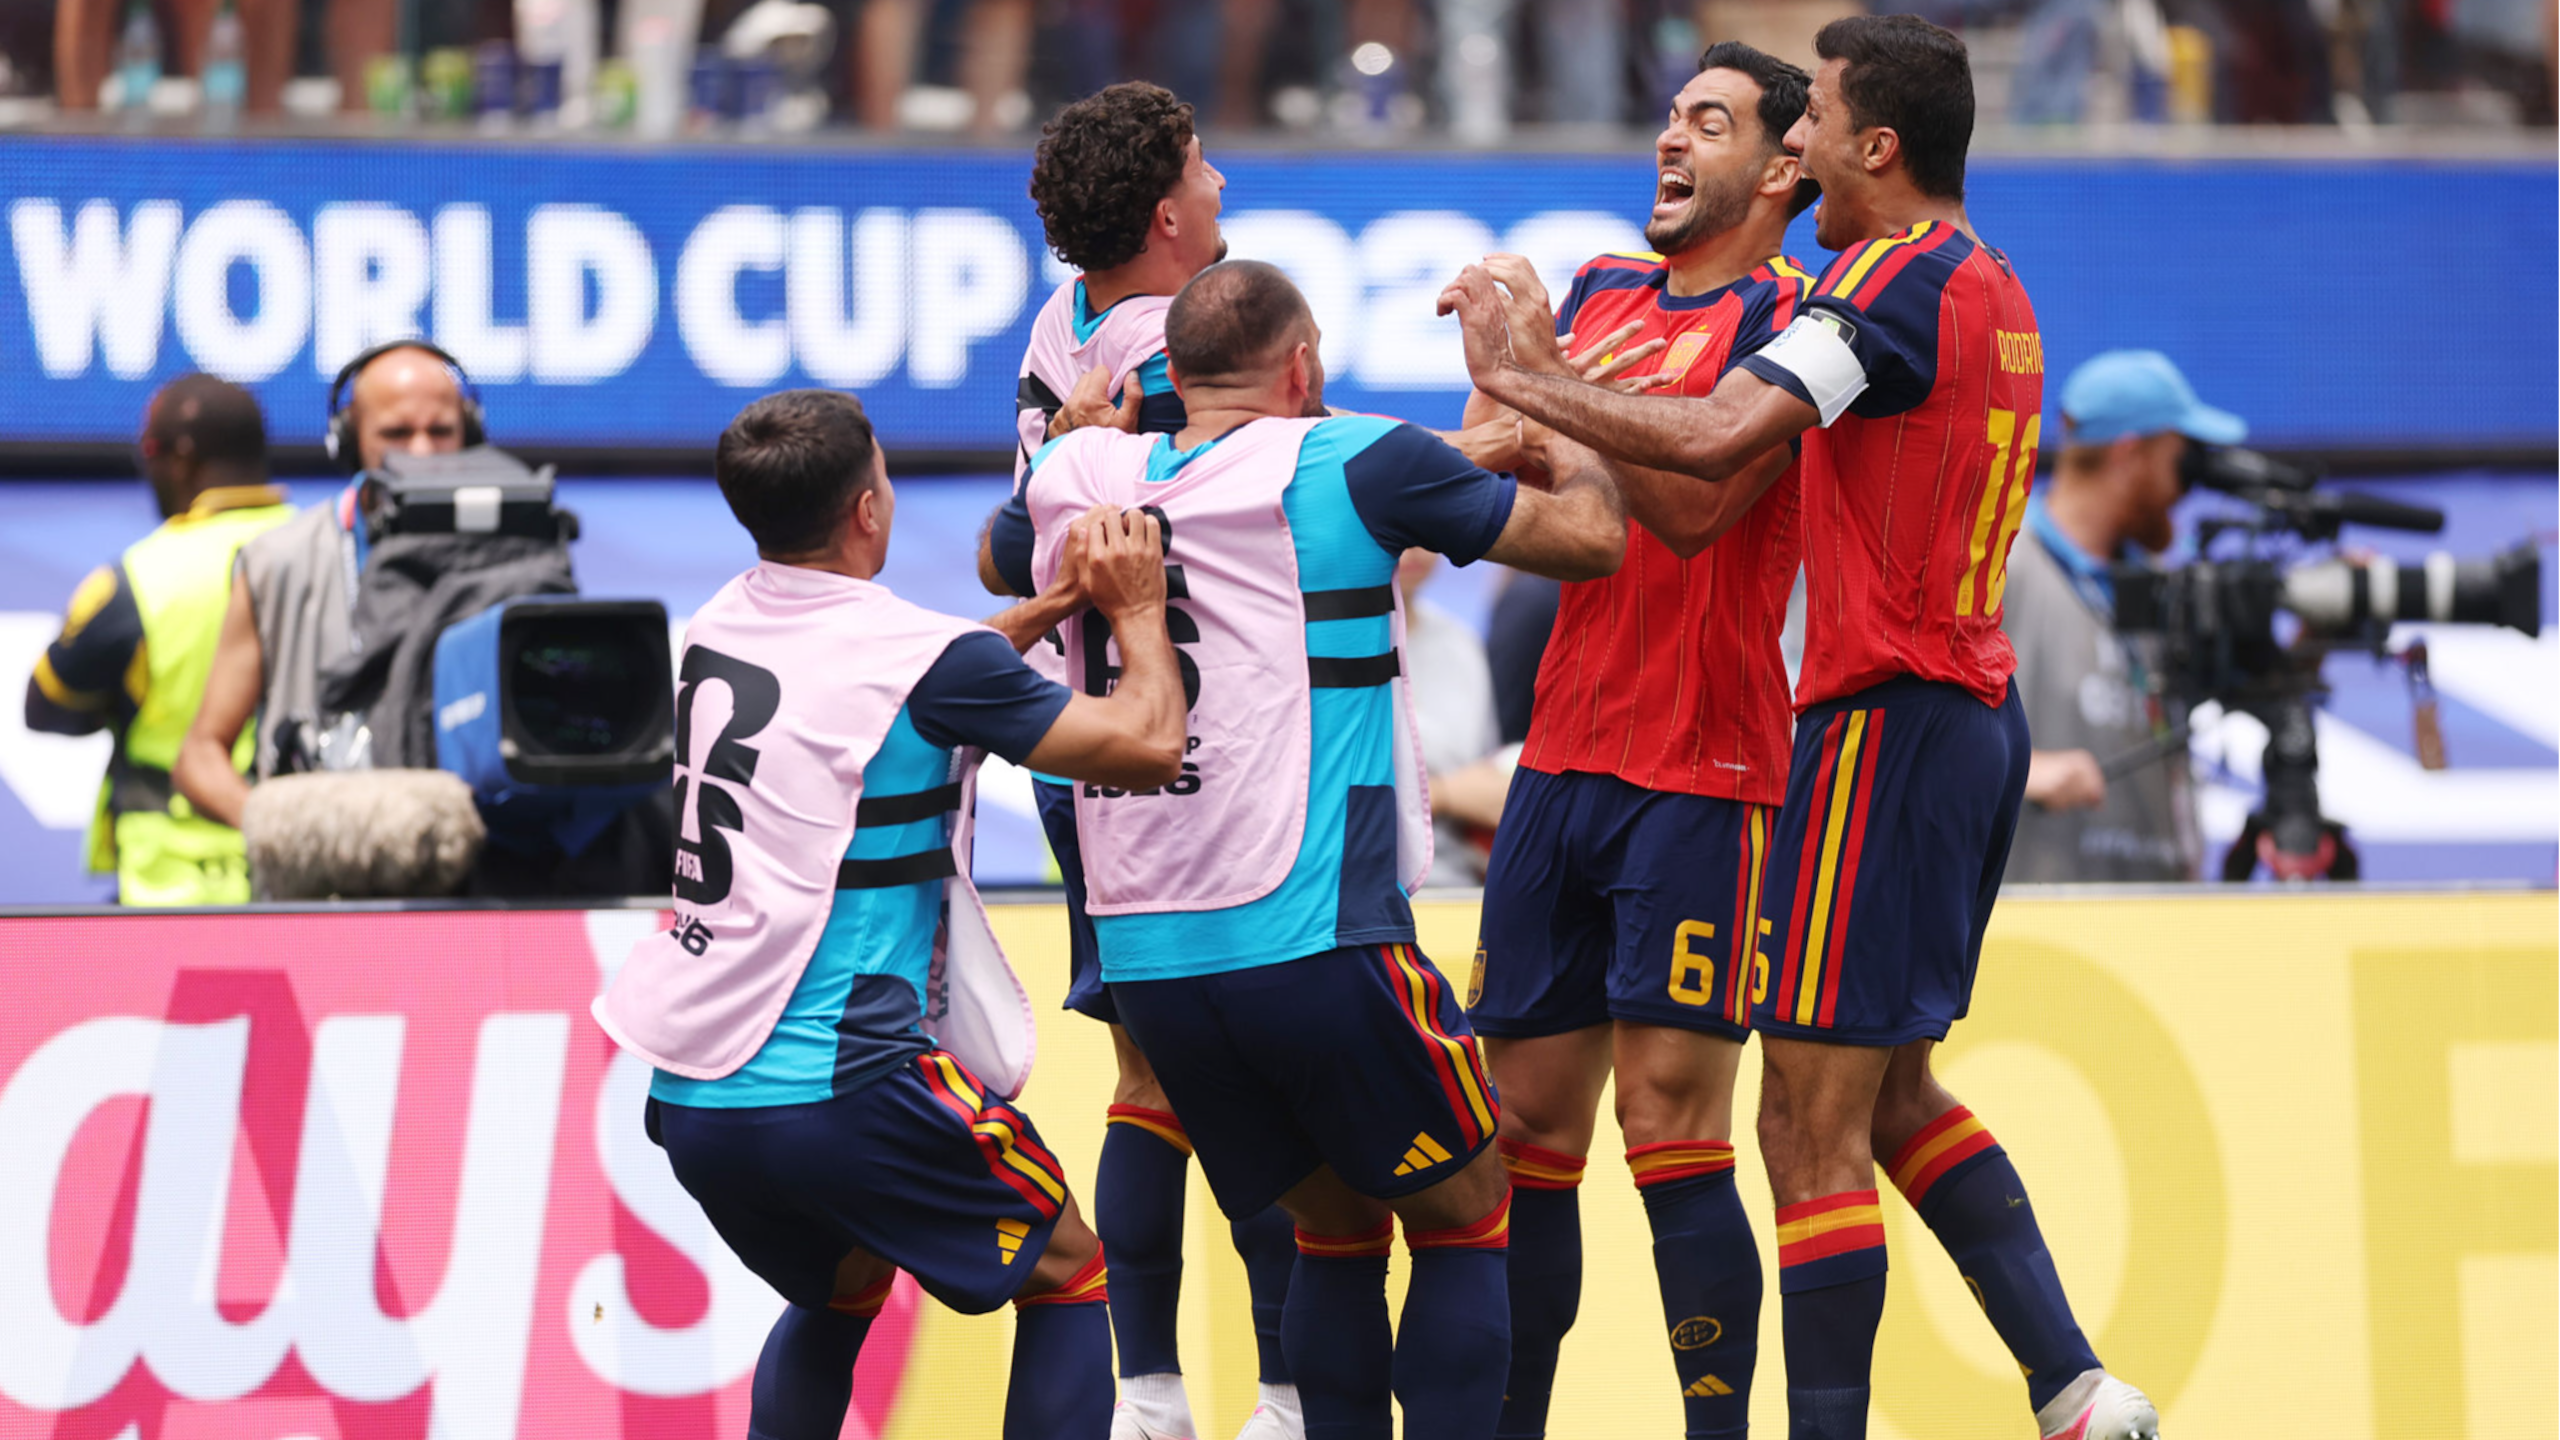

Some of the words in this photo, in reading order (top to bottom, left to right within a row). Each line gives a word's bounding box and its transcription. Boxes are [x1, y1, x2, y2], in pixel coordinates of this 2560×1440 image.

[10, 197, 658, 386] WORLD
[674, 203, 1028, 390] CUP
[675, 847, 704, 883] FIFA
[1668, 919, 1715, 1006] 6
